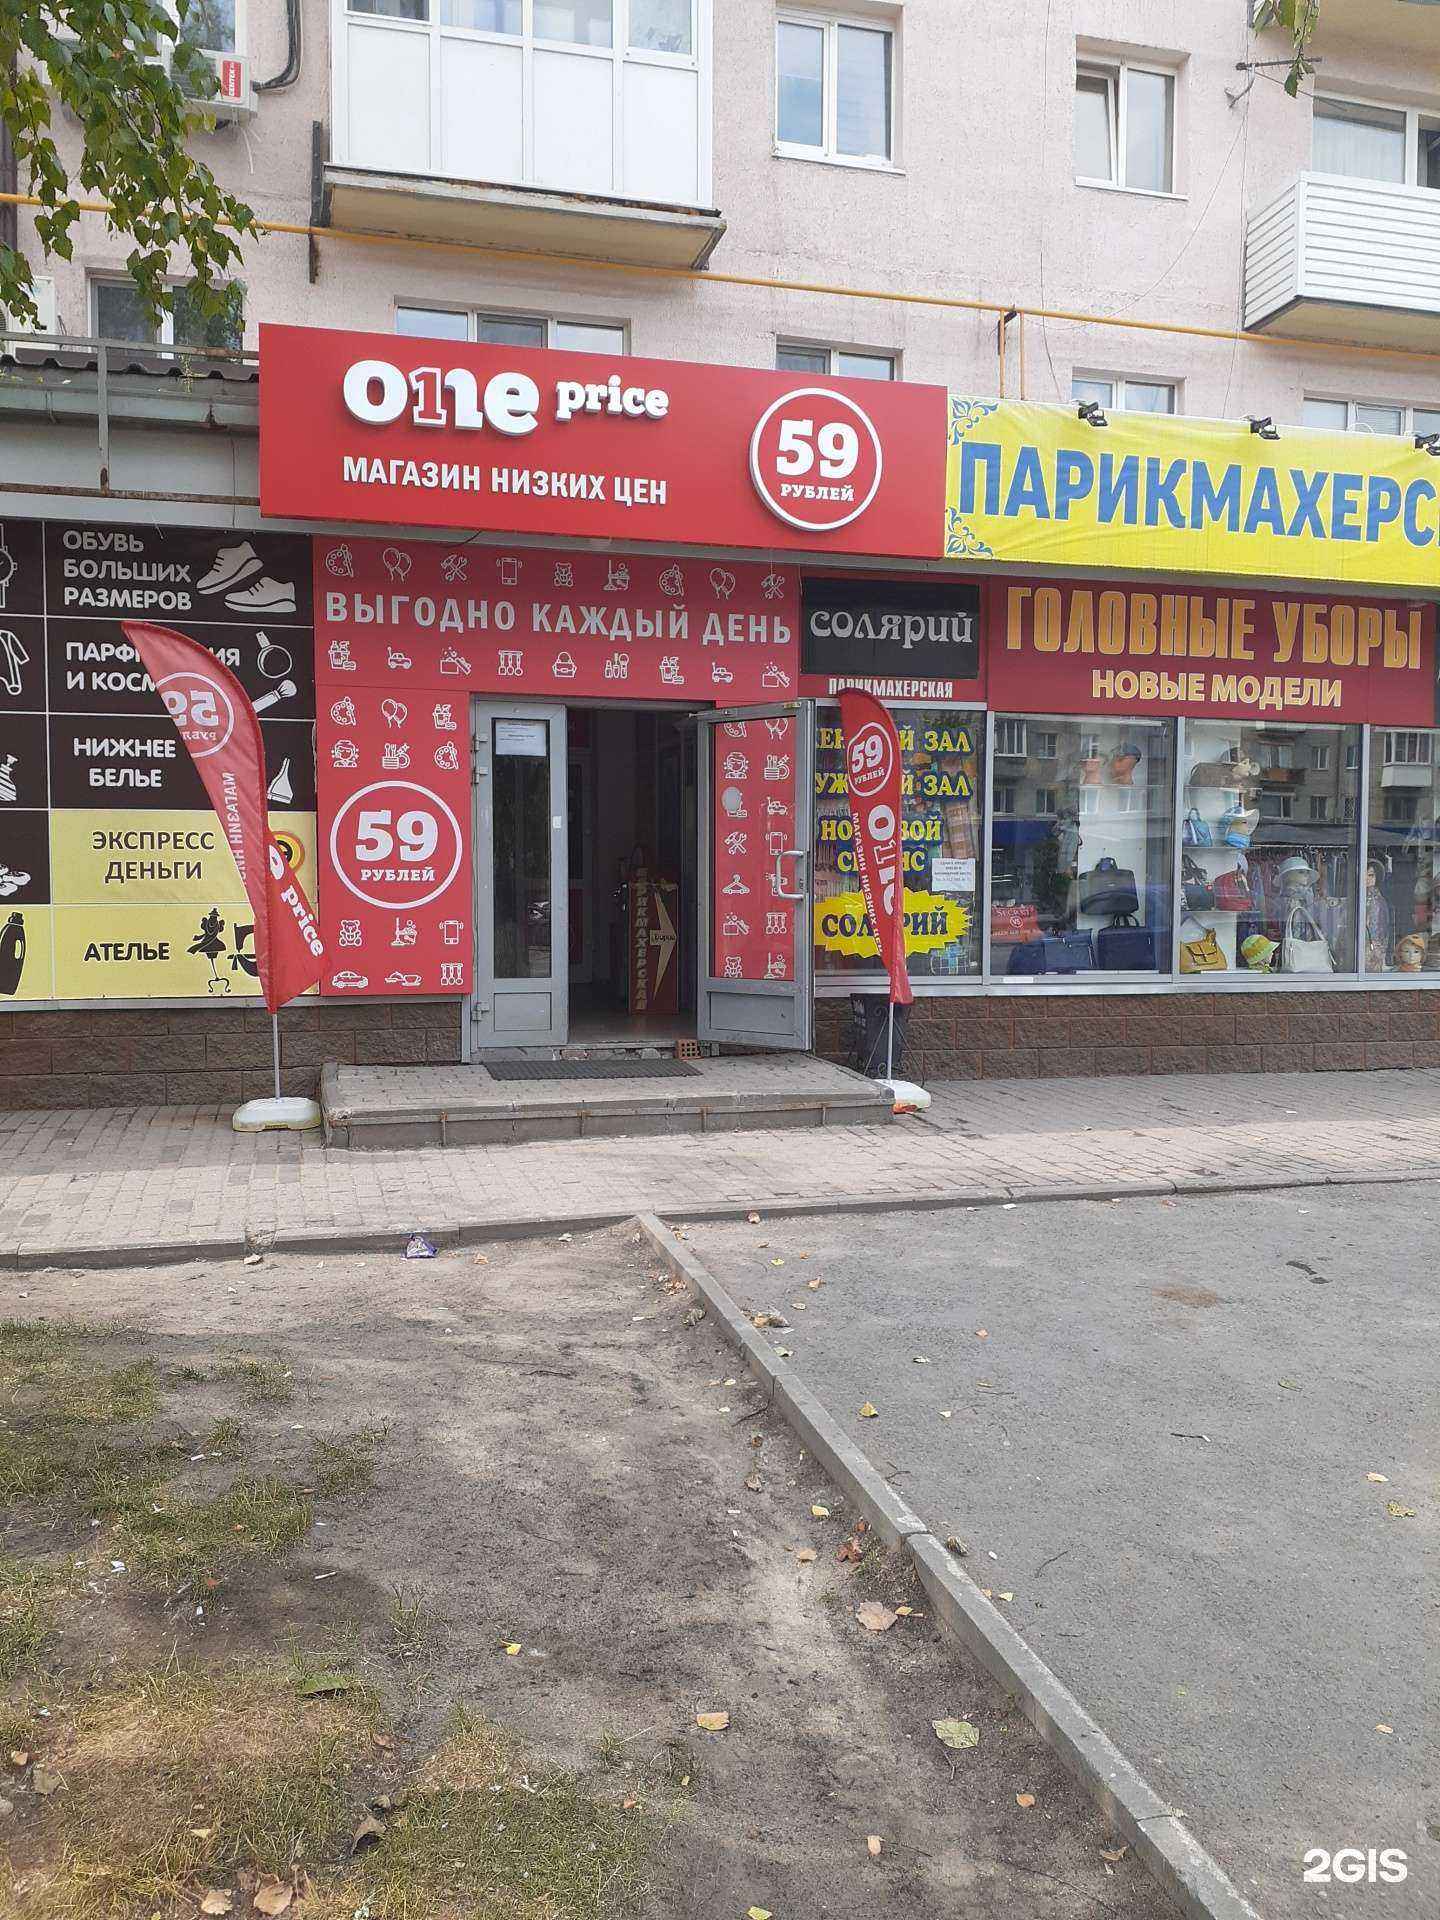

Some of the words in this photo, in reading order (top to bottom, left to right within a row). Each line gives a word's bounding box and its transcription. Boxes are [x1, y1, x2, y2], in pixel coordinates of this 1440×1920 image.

[556, 374, 669, 421] price
[776, 418, 860, 479] 59
[343, 456, 480, 490] МАГАЗИН
[491, 467, 605, 500] НИЗКИХ
[614, 476, 667, 506] ЦЕН
[780, 482, 855, 503] РУБЛЕЙ
[959, 441, 1440, 547] ПАРИКМАХЕРС
[63, 530, 145, 552] ОБУВЬ
[63, 558, 192, 583] БОЛЬШИХ
[64, 587, 192, 610] РАЗМЕРОВ
[325, 591, 516, 633] ВЫГОДНО
[532, 601, 690, 640] КАЖДЫЙ
[701, 611, 792, 646] ДЕНЬ
[1006, 586, 1256, 662] ГОЛОВНЫЕ
[1272, 601, 1422, 670] УБОРЫ
[66, 671, 85, 690] И
[1092, 669, 1205, 702] НОВЫЕ
[1211, 675, 1342, 711] МОДЕЛИ
[74, 737, 176, 758] НИЖНЕЕ
[924, 730, 971, 752] ЗАЛ
[852, 734, 883, 773] 59
[89, 768, 162, 787] БЕЛЬЕ
[854, 766, 886, 785] РУБЛЕЙ
[924, 774, 970, 796] ЗАЛ
[92, 831, 215, 850] ЭКСПРЕСС
[355, 809, 439, 862] 59
[105, 861, 202, 883] ДЕНЬГИ
[360, 866, 435, 881] РУБЛЕЙ
[851, 812, 867, 871] МАГАЗИН
[861, 874, 877, 925] НИЗКИХ
[281, 885, 324, 957] price
[84, 942, 169, 961] АТЕЛЬЕ
